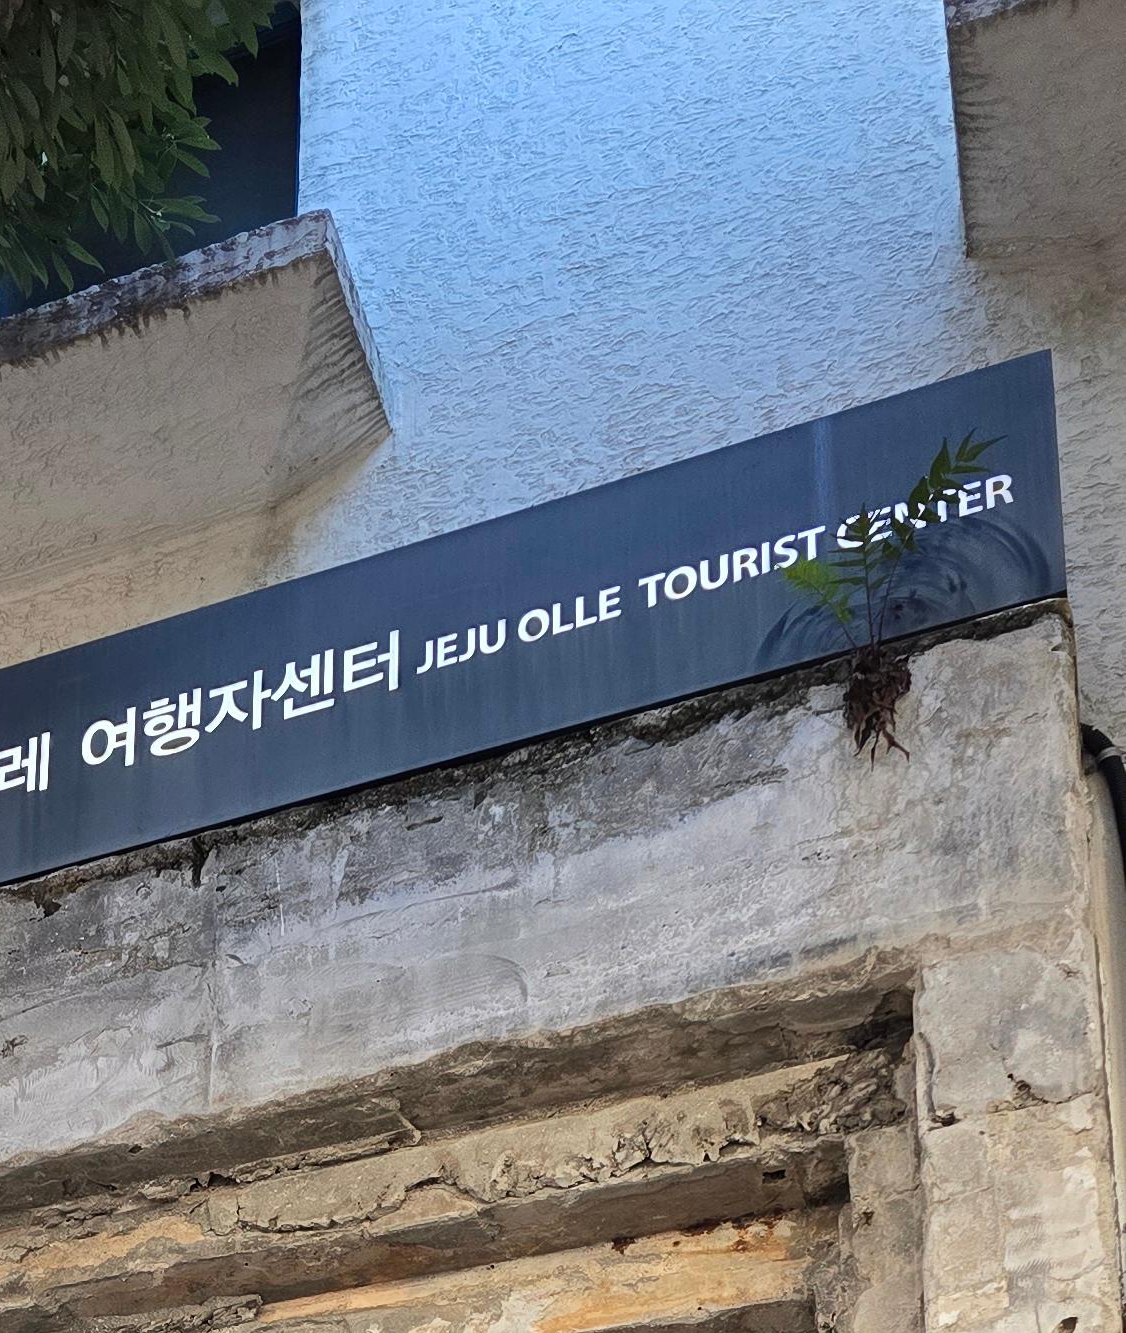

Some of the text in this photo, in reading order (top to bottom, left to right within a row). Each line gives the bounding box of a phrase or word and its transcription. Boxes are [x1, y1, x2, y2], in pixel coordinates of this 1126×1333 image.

[415, 474, 1014, 676] JEJU OLLE TOURIST CENTER
[81, 629, 400, 767] 여행자센터
